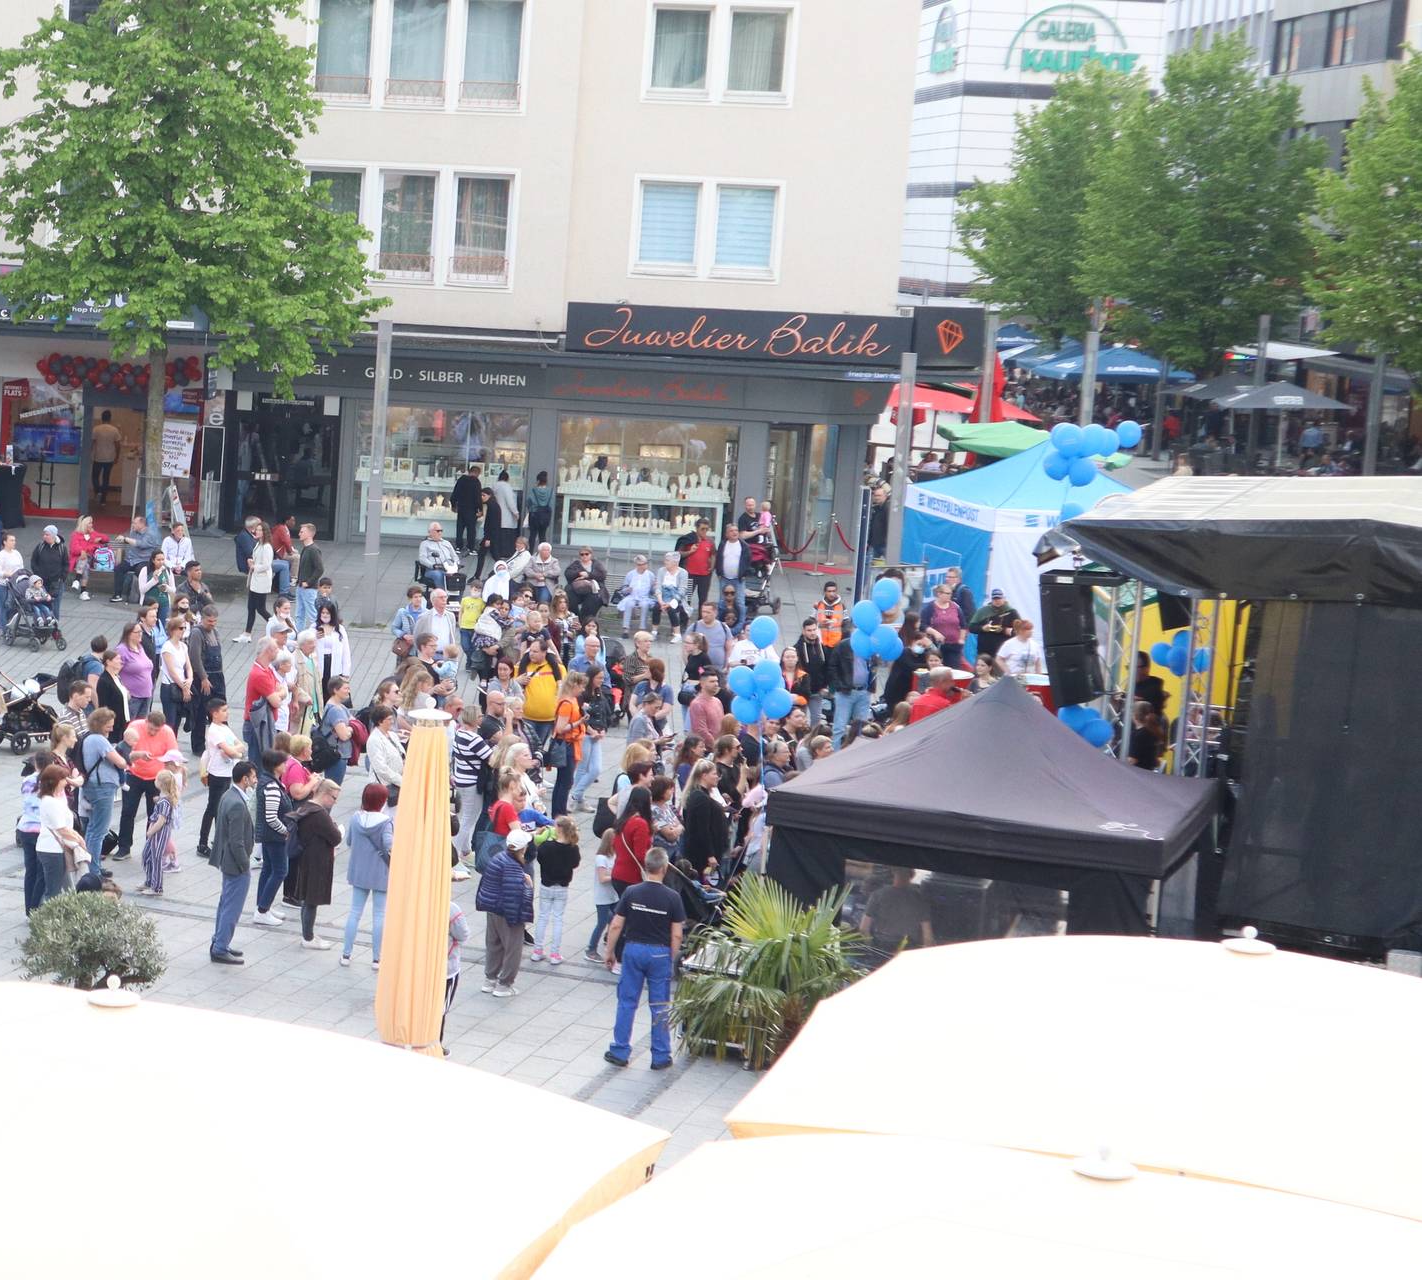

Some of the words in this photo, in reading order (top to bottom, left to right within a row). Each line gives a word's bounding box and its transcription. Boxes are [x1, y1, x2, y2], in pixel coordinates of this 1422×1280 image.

[1036, 19, 1097, 43] GALERIA
[584, 307, 758, 351] Juwelier
[763, 314, 891, 358] Balik
[419, 369, 464, 384] SILBER
[479, 373, 526, 387] UHREN
[3, 389, 22, 397] FLATS
